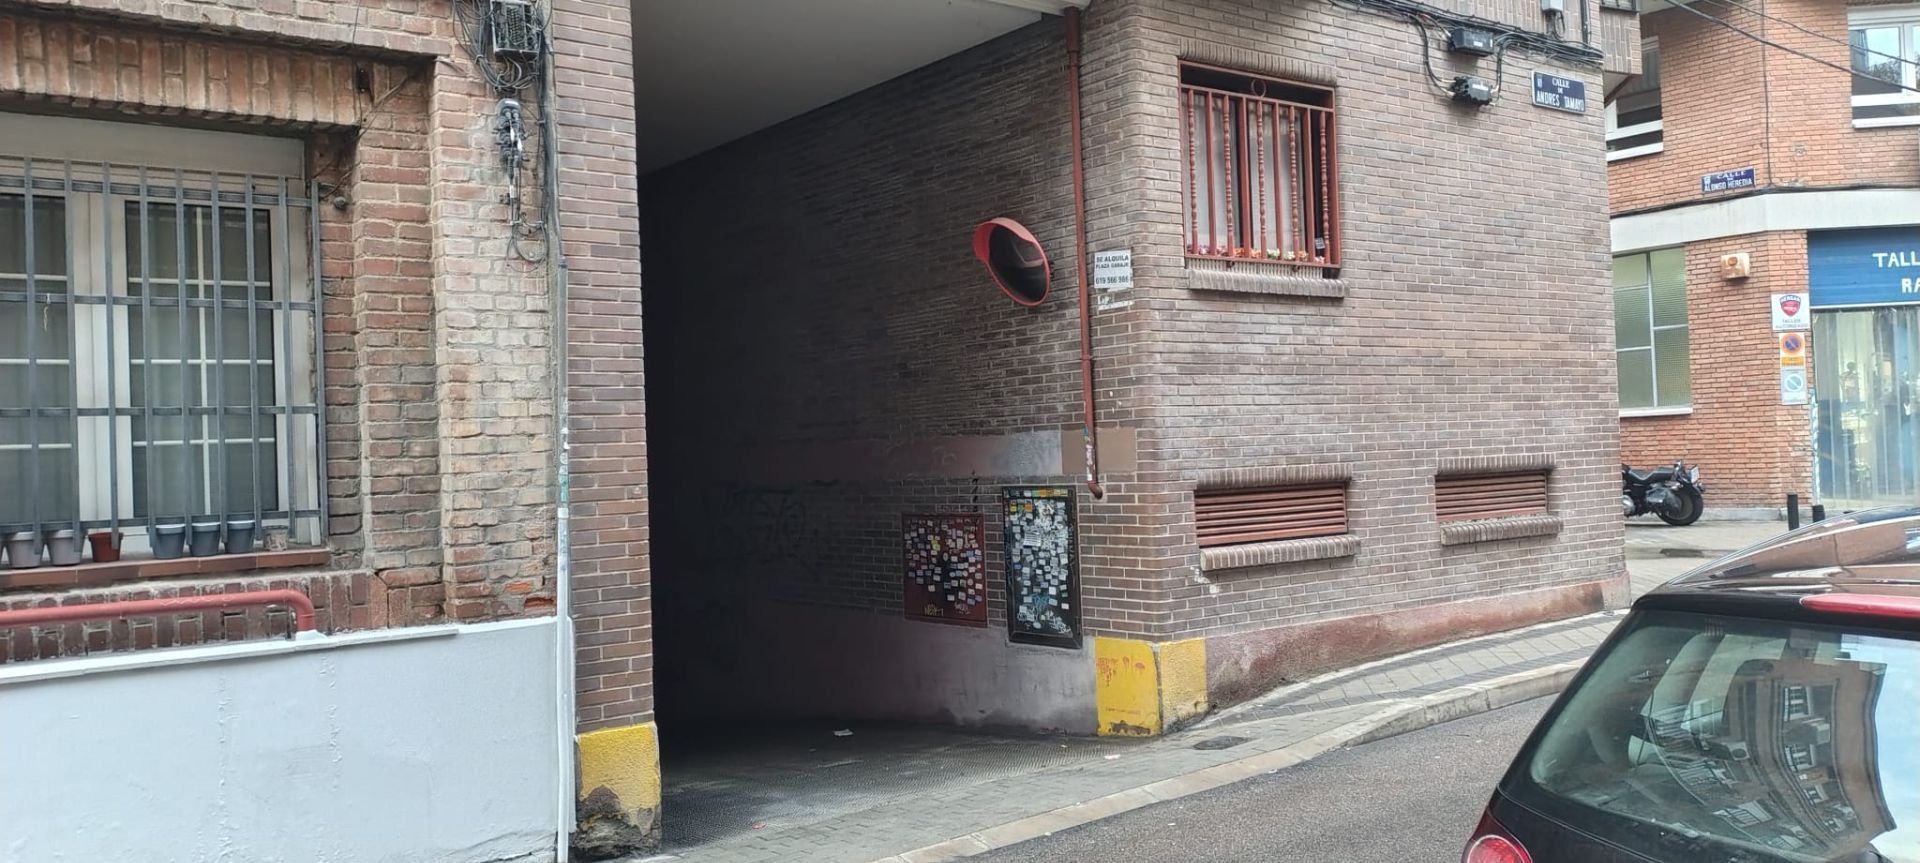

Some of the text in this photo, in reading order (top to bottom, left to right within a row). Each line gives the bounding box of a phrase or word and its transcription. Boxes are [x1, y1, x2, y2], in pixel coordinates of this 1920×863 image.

[1552, 77, 1570, 88] CALLE
[1536, 90, 1560, 106] ANDRES
[1717, 171, 1746, 179] CALLE
[1727, 178, 1753, 189] HEREDIA
